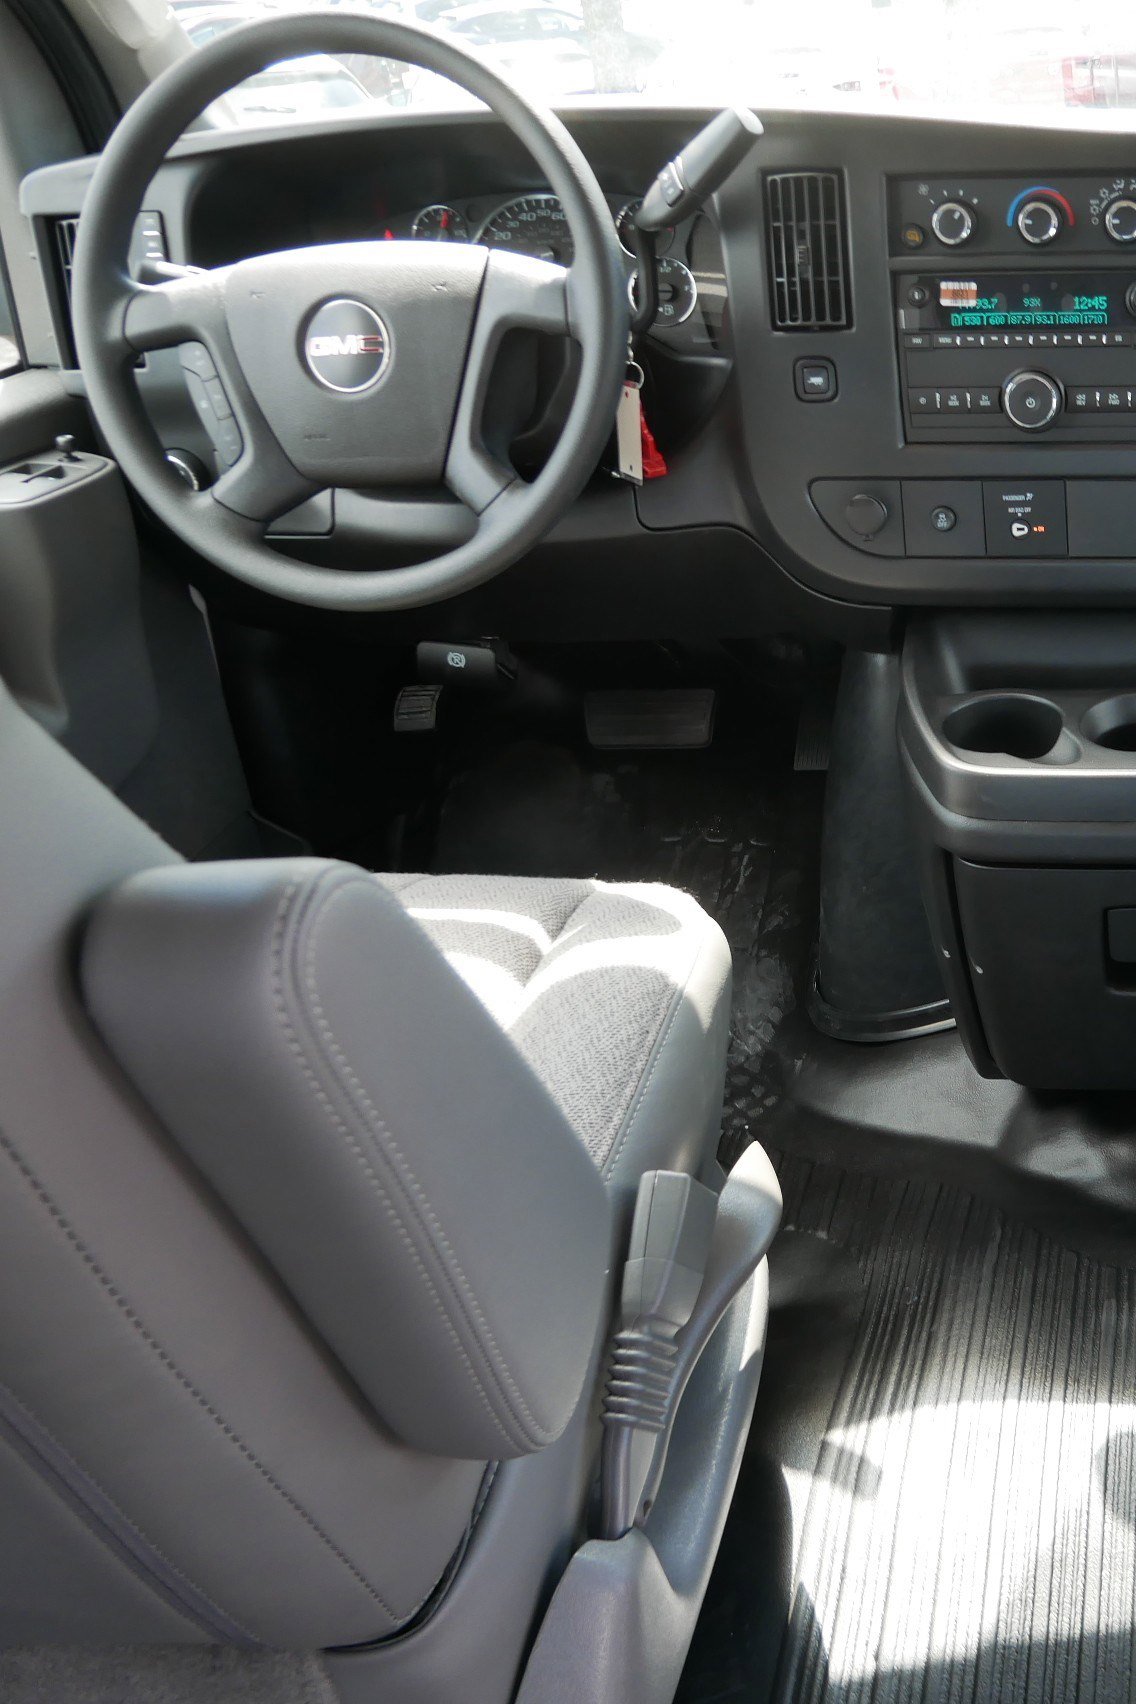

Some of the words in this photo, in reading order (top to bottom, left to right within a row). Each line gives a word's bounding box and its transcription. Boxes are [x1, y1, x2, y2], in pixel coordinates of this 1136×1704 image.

[518, 212, 536, 221] 40
[493, 231, 511, 240] 20
[1073, 296, 1108, 310] 12:45
[1010, 315, 1032, 325] 87.9
[1035, 315, 1055, 324] 93.1
[1060, 315, 1080, 324] 1600
[308, 334, 384, 357] GMC
